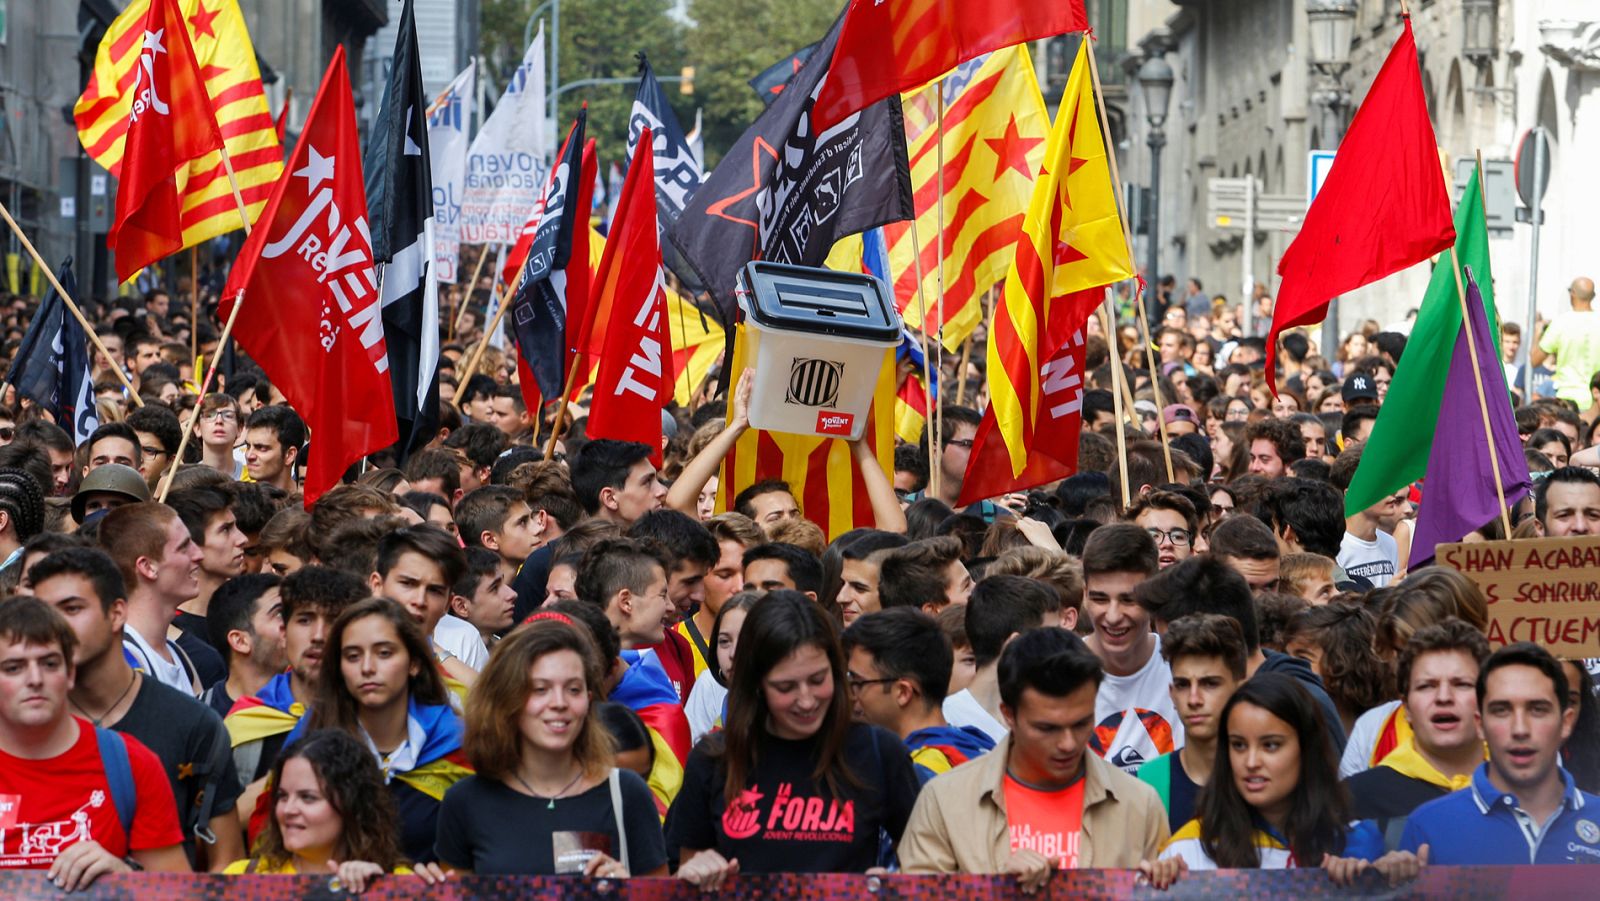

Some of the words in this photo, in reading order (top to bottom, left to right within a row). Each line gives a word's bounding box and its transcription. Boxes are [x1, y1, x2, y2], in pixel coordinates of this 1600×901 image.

[1445, 546, 1515, 572] S'HAN
[1513, 581, 1600, 604] SOMRIUR
[766, 796, 854, 833] FORJA
[763, 831, 793, 841] JOVENT
